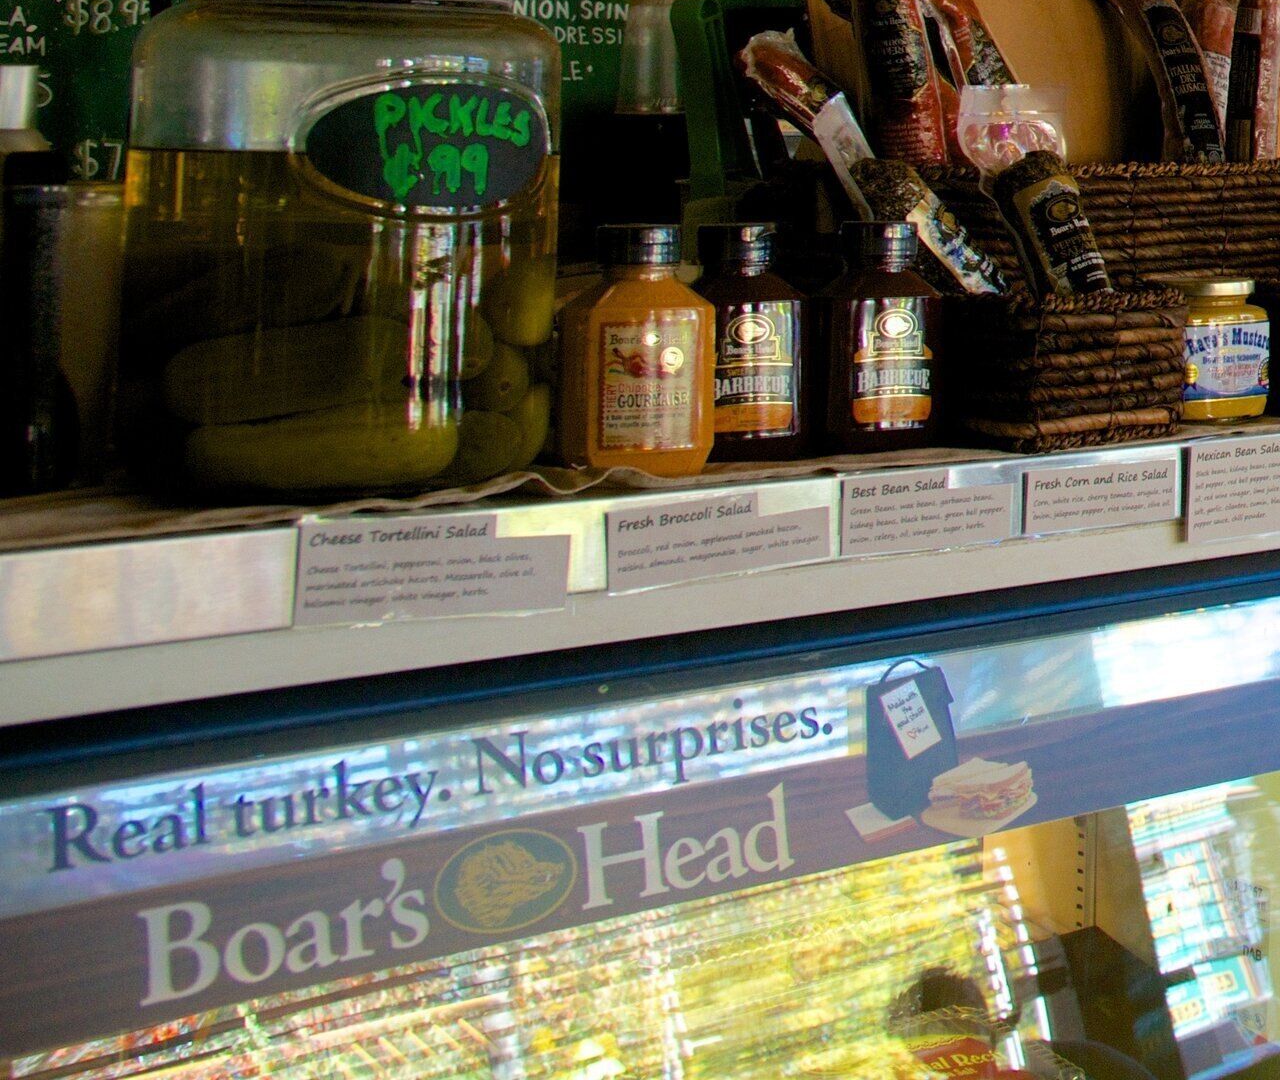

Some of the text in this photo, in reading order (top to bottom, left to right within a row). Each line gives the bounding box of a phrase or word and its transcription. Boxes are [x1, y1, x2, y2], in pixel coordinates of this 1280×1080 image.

[373, 90, 532, 162] PICKLES
[714, 374, 790, 400] BARBECUE
[857, 368, 931, 393] BARBECUE
[1196, 449, 1232, 463] Mexican
[1234, 445, 1257, 458] Bean
[851, 476, 946, 499] Best Bean Salad
[1034, 467, 1168, 491] Fresh Corn and Rice Salad
[617, 500, 752, 533] Fresh Broccoli Salad
[309, 522, 488, 548] Cheese Tortellini Salad
[46, 782, 212, 874] Real
[231, 760, 453, 830] turkey.
[471, 729, 567, 798] No
[580, 697, 836, 787] surprises.
[138, 781, 796, 1009] Boar's Head
